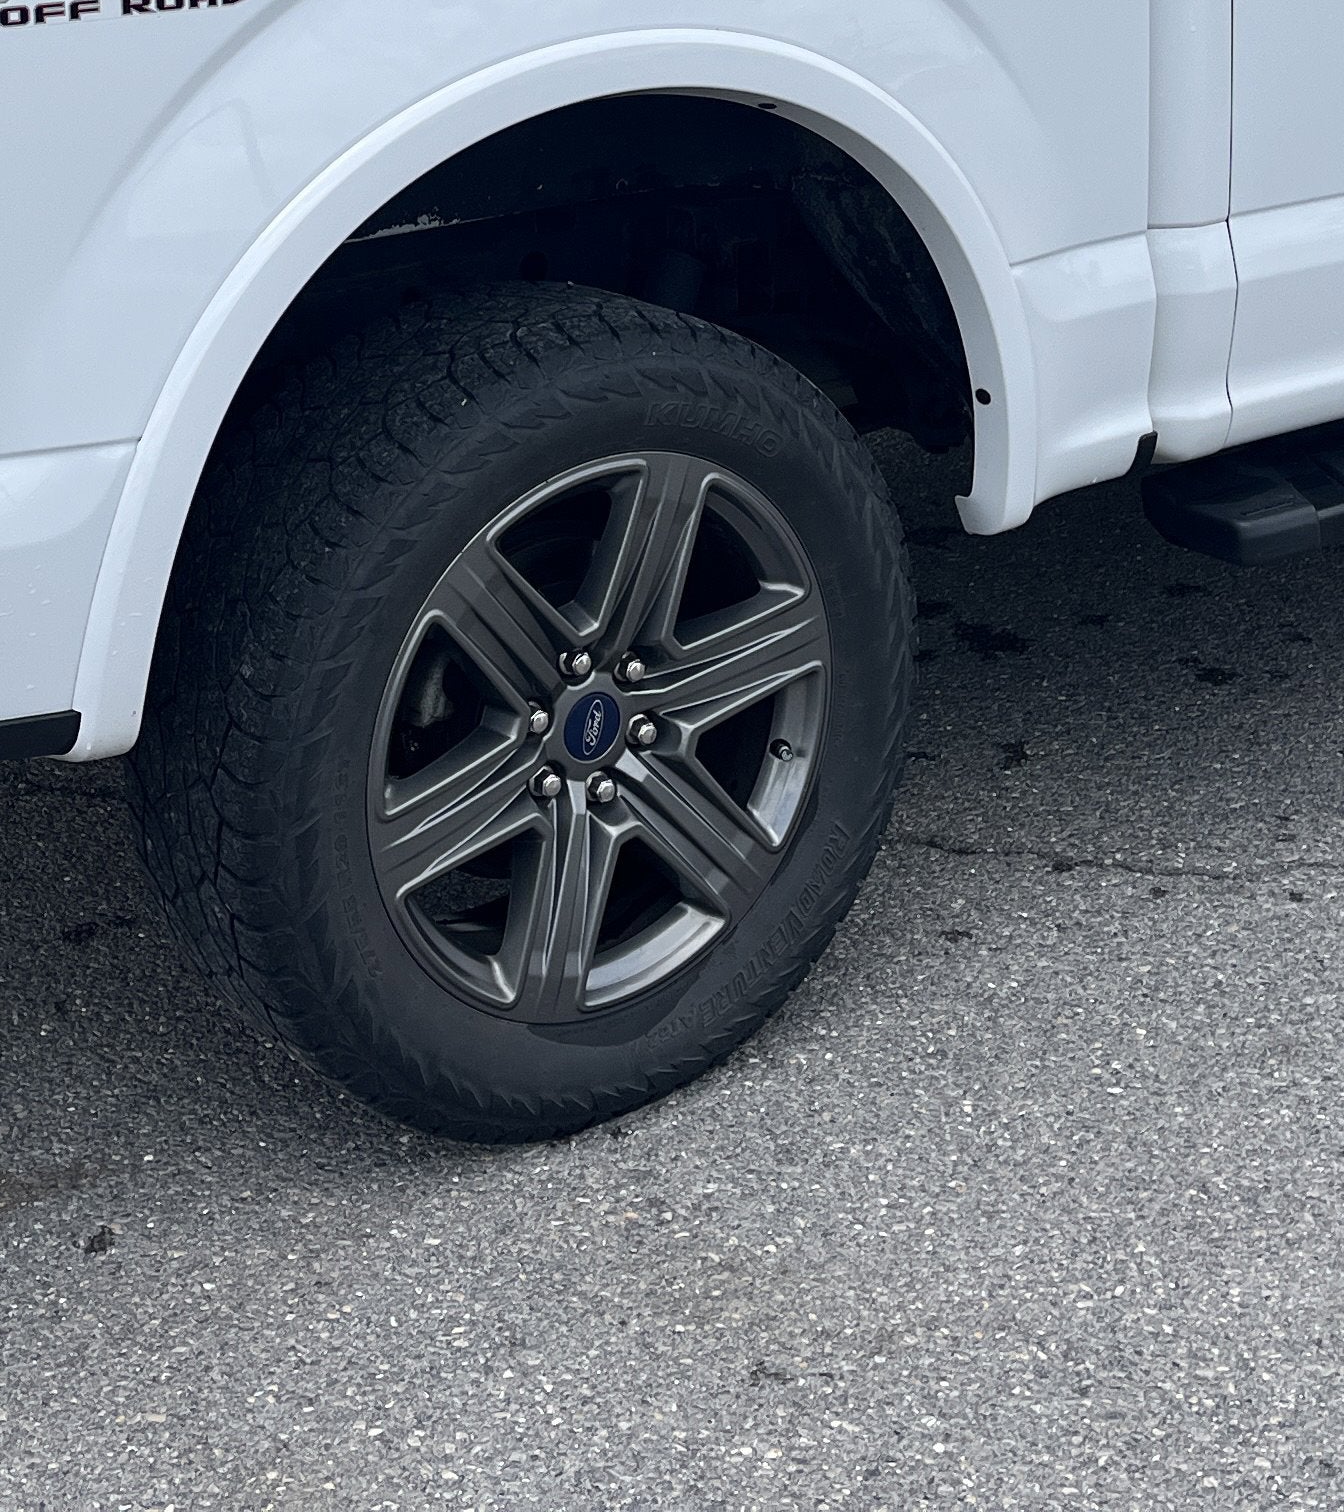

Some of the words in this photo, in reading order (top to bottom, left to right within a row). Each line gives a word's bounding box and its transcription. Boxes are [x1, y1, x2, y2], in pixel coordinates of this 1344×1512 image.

[643, 399, 784, 459] KUMHO
[584, 709, 603, 747] Ford
[701, 820, 852, 1028] ROADVENTURE
